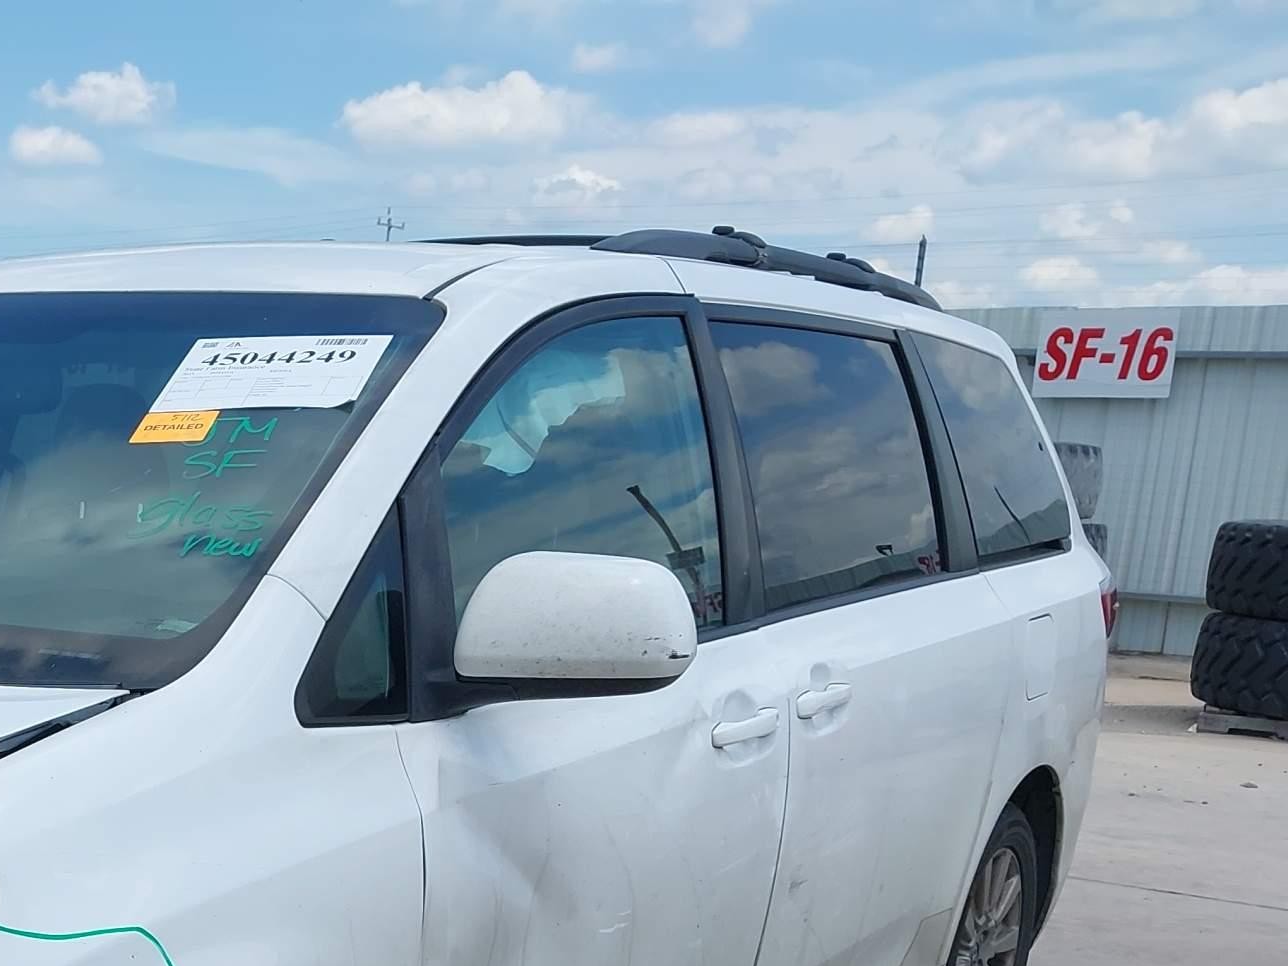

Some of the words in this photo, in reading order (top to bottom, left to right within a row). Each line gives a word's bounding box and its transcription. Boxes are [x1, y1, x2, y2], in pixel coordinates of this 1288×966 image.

[200, 350, 357, 366] 45044249
[1037, 327, 1174, 381] SF-16
[143, 422, 204, 431] DETAILED
[182, 449, 268, 479] SF
